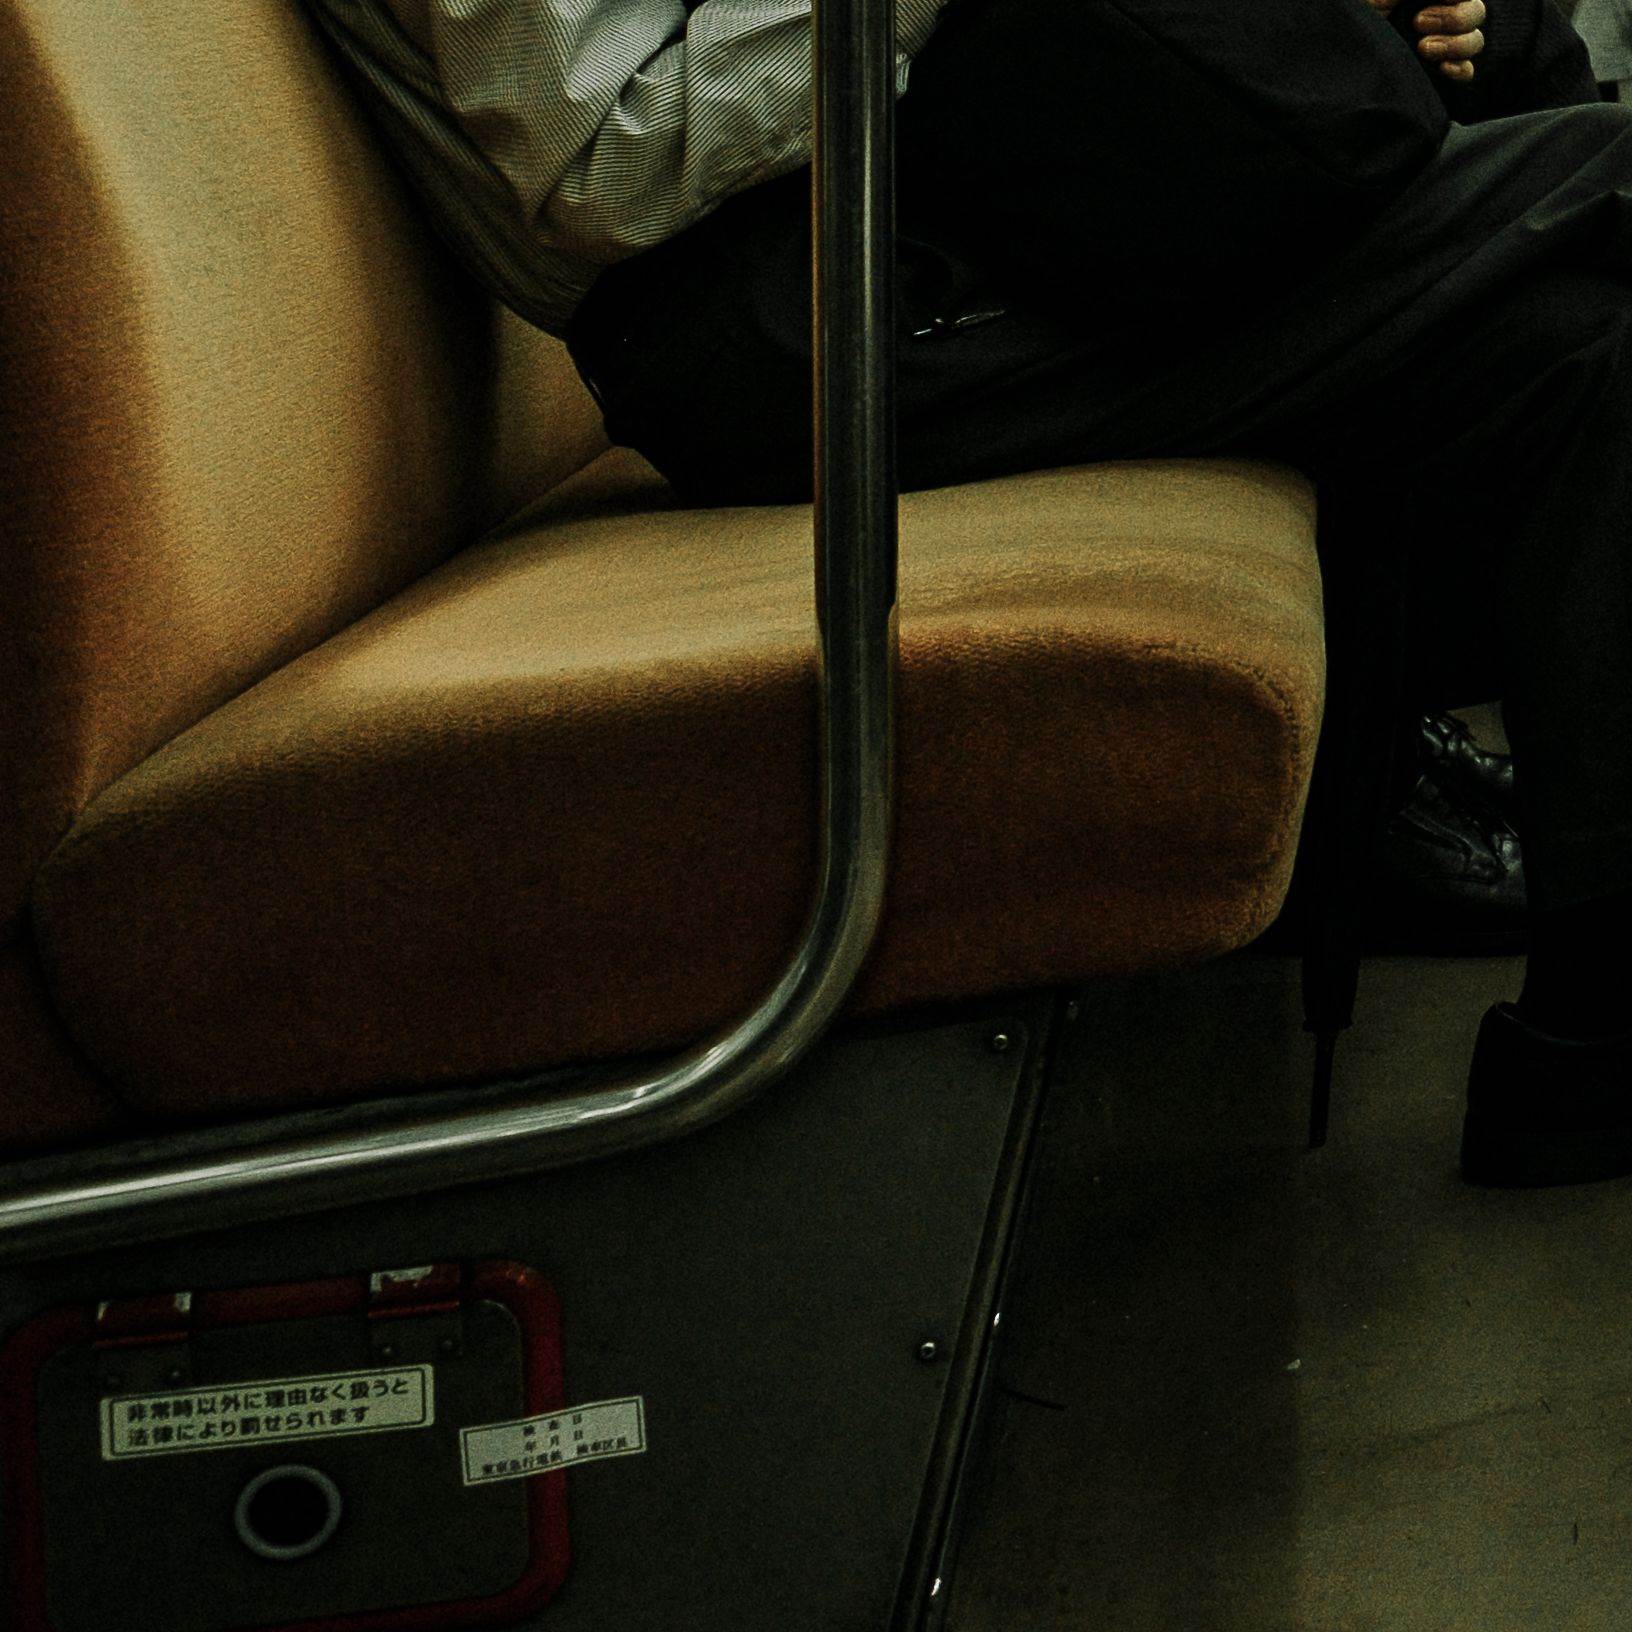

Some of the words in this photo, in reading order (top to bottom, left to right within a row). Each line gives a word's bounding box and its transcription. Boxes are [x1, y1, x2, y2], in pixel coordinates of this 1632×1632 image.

[126, 1378, 410, 1423] 非常時以外に理由なく扱うと
[128, 1406, 370, 1446] 法律により罰せられます
